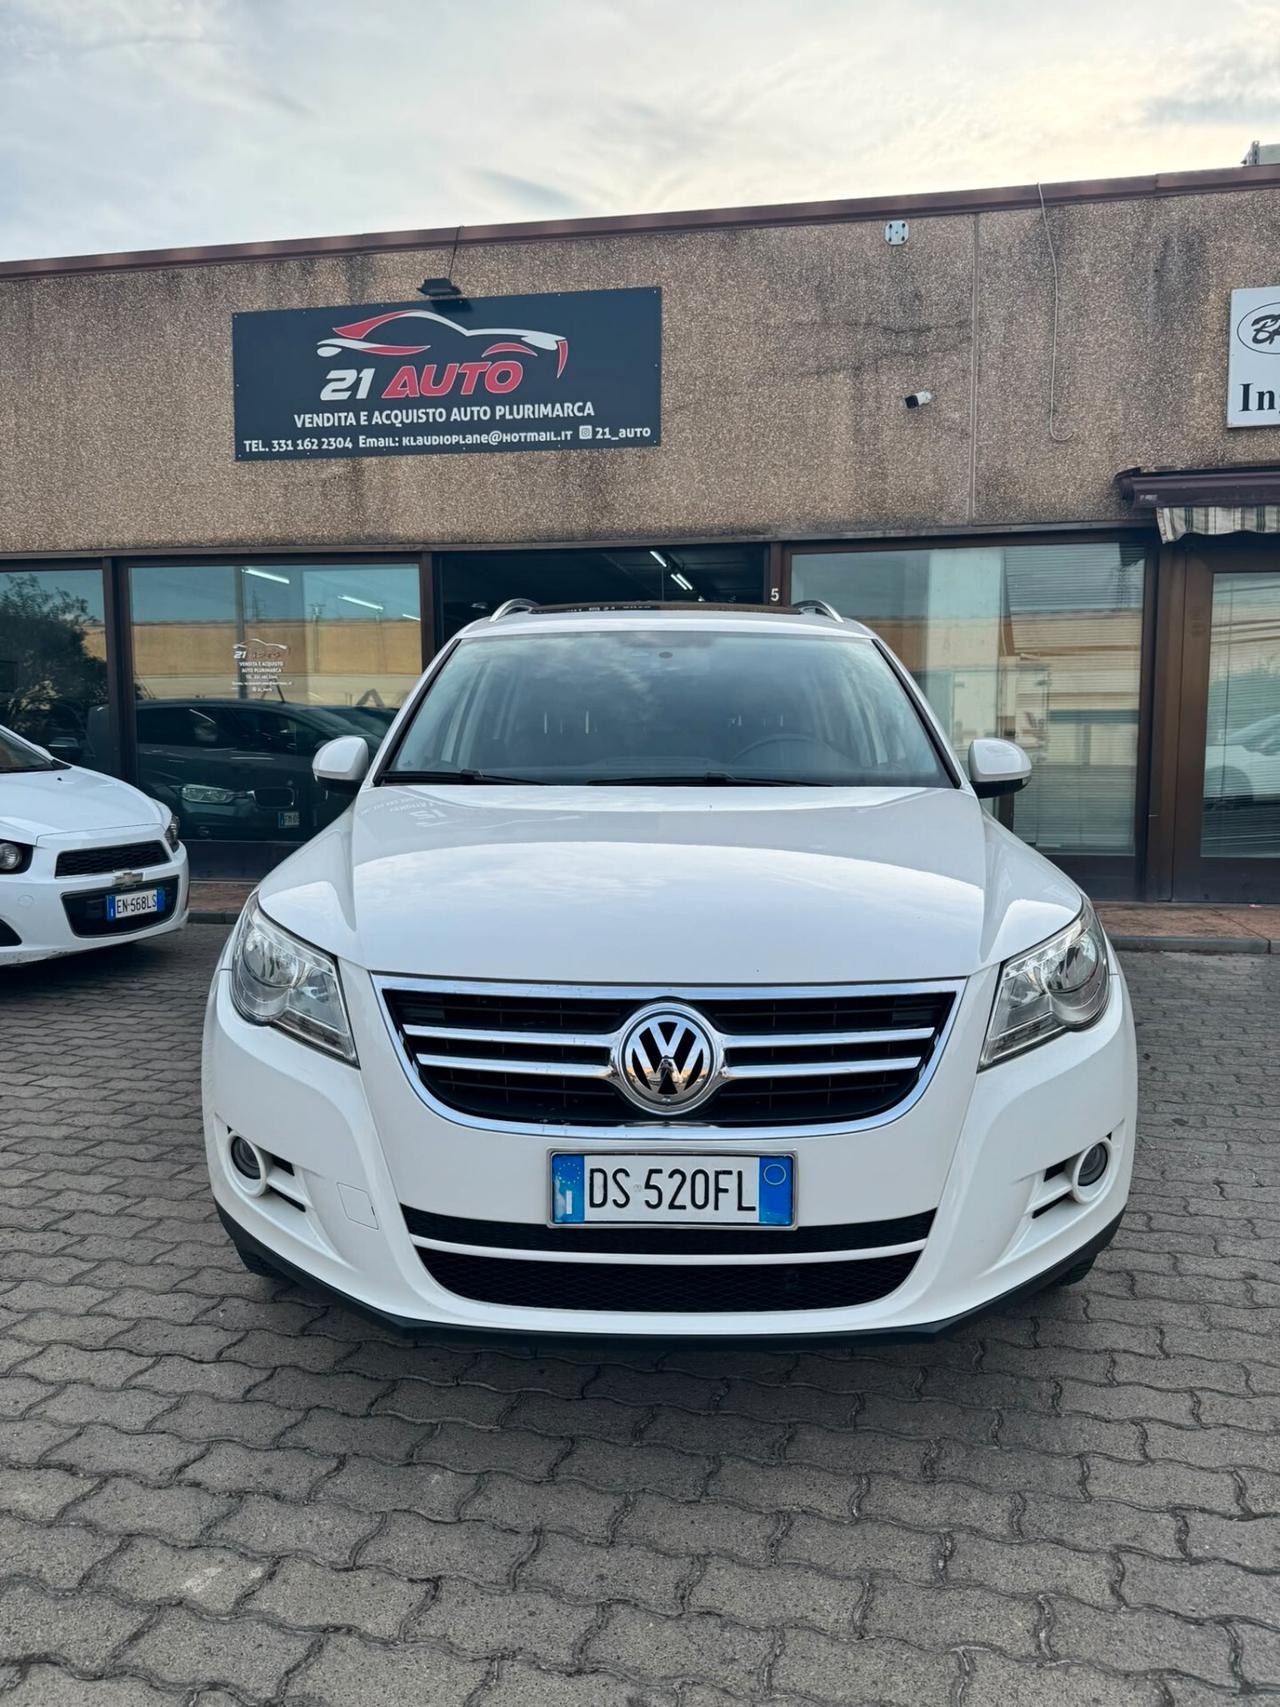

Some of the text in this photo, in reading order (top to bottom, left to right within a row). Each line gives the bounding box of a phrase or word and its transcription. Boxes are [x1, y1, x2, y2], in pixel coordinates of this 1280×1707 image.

[319, 360, 524, 401] 21 AUTO
[1238, 382, 1280, 414] In
[294, 401, 595, 428] VENDITA E ACQUISTO AUTO PLURIMARCA
[243, 440, 269, 452] TEL.
[271, 439, 294, 451] 331
[296, 438, 319, 450] 162
[321, 437, 353, 449] 2304
[770, 588, 779, 601] 5
[233, 651, 247, 659] 21
[589, 1168, 631, 1209] DS
[643, 1168, 757, 1211] 520FL
